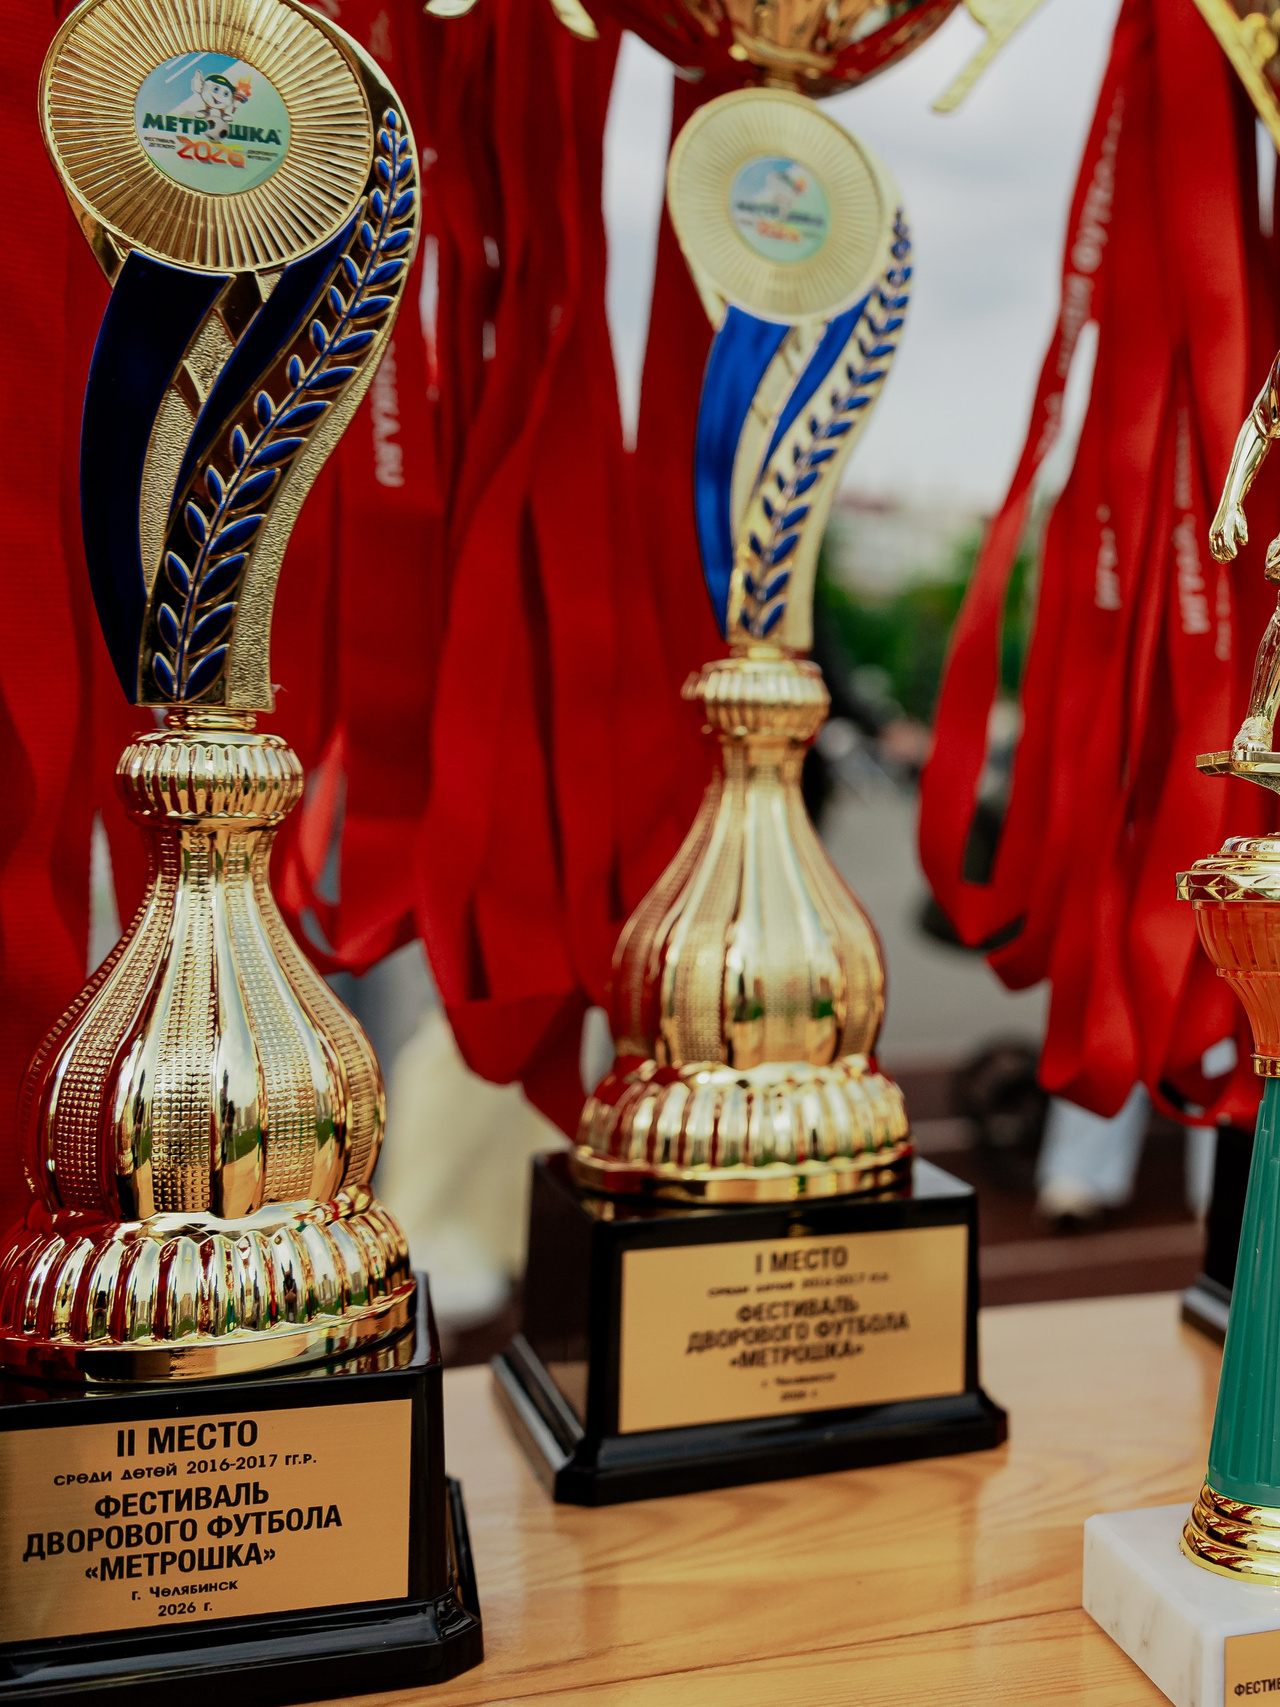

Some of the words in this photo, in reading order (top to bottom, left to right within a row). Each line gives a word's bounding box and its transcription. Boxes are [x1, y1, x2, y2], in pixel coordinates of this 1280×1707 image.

[176, 136, 245, 168] 2026
[770, 1246, 849, 1273] МЕСТО
[737, 1295, 859, 1323] ФЕСТИВАЛЬ
[686, 1322, 809, 1355] ДВОРОВОГО
[814, 1311, 910, 1339] ФУТБОЛА
[148, 1419, 258, 1454] МЕСТО
[186, 1453, 278, 1474] 2016-2017
[94, 1481, 269, 1519] ФЕСТИВАЛЬ
[23, 1517, 197, 1561] ДВОРОВОГО
[207, 1505, 342, 1539] ФУТБОЛА
[85, 1543, 276, 1581] «МЕТРОШКА»
[150, 1580, 238, 1598] Челябинск
[158, 1602, 196, 1617] 2026
